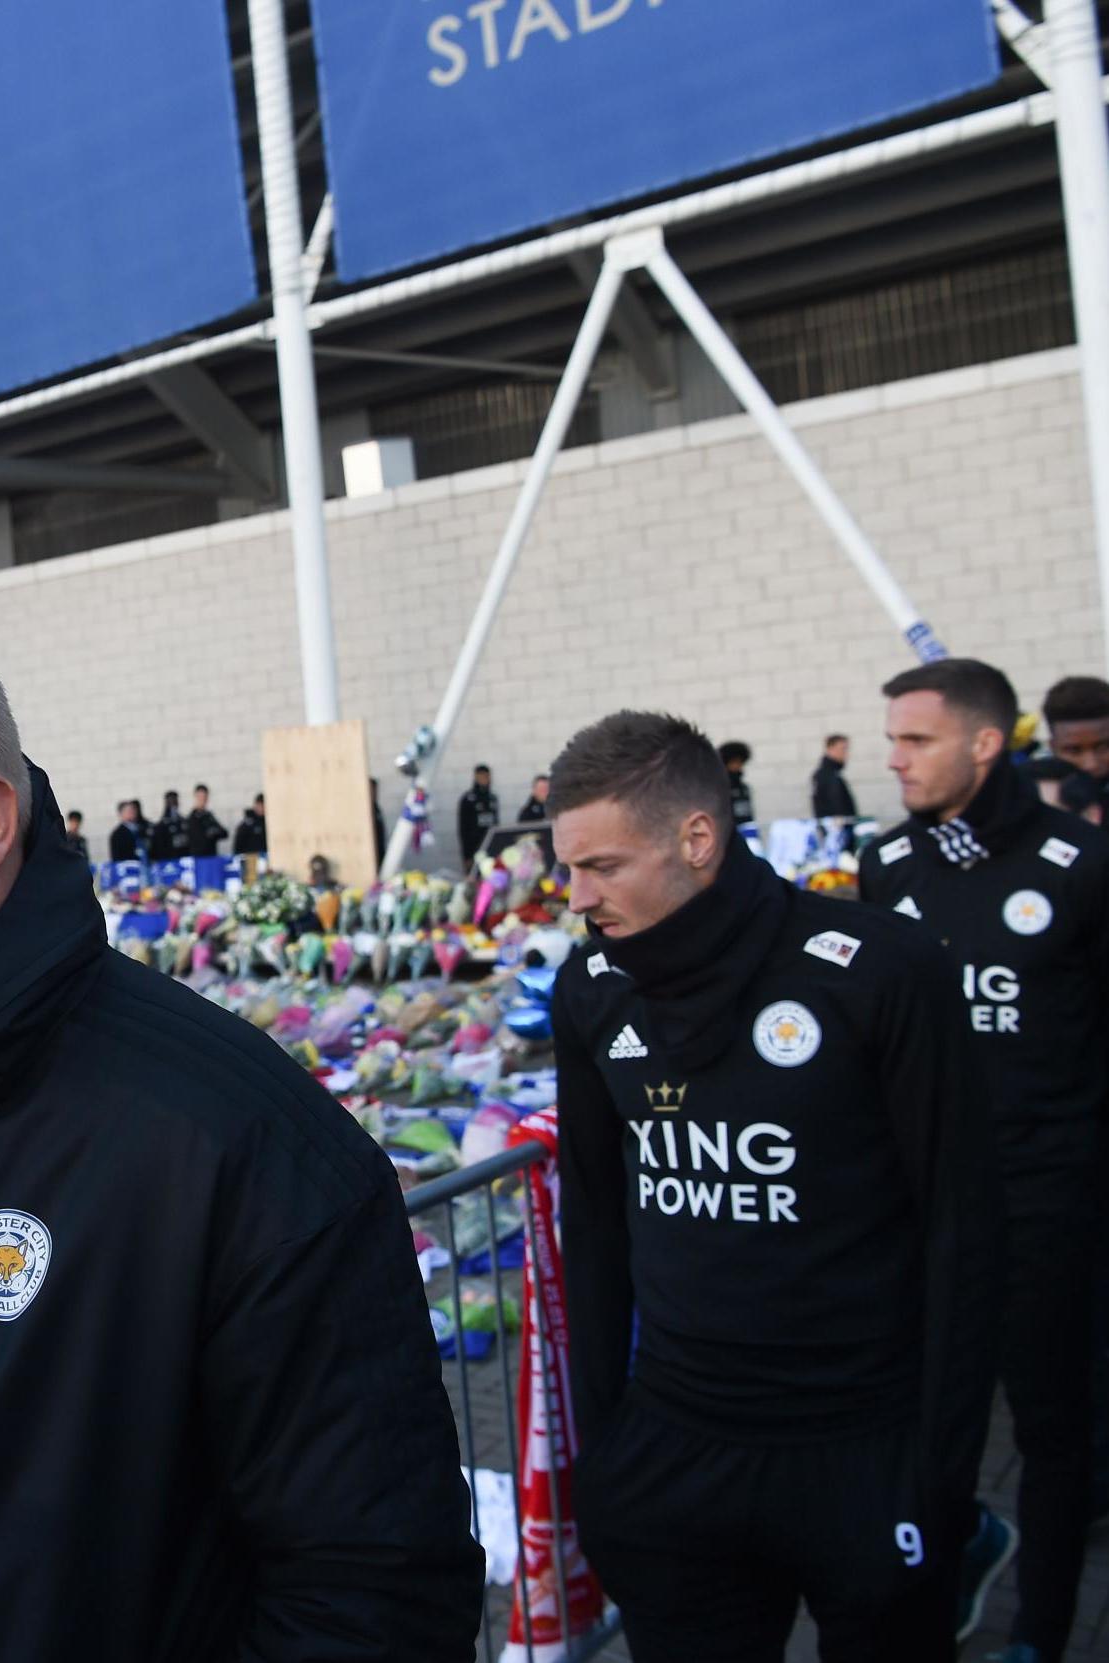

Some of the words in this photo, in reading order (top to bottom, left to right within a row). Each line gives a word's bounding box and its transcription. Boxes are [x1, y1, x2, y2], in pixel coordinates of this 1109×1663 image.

[638, 1173, 800, 1223] POWER
[31, 1230, 47, 1261] CITY
[20, 1269, 43, 1304] CLUB
[894, 1521, 924, 1567] 9
